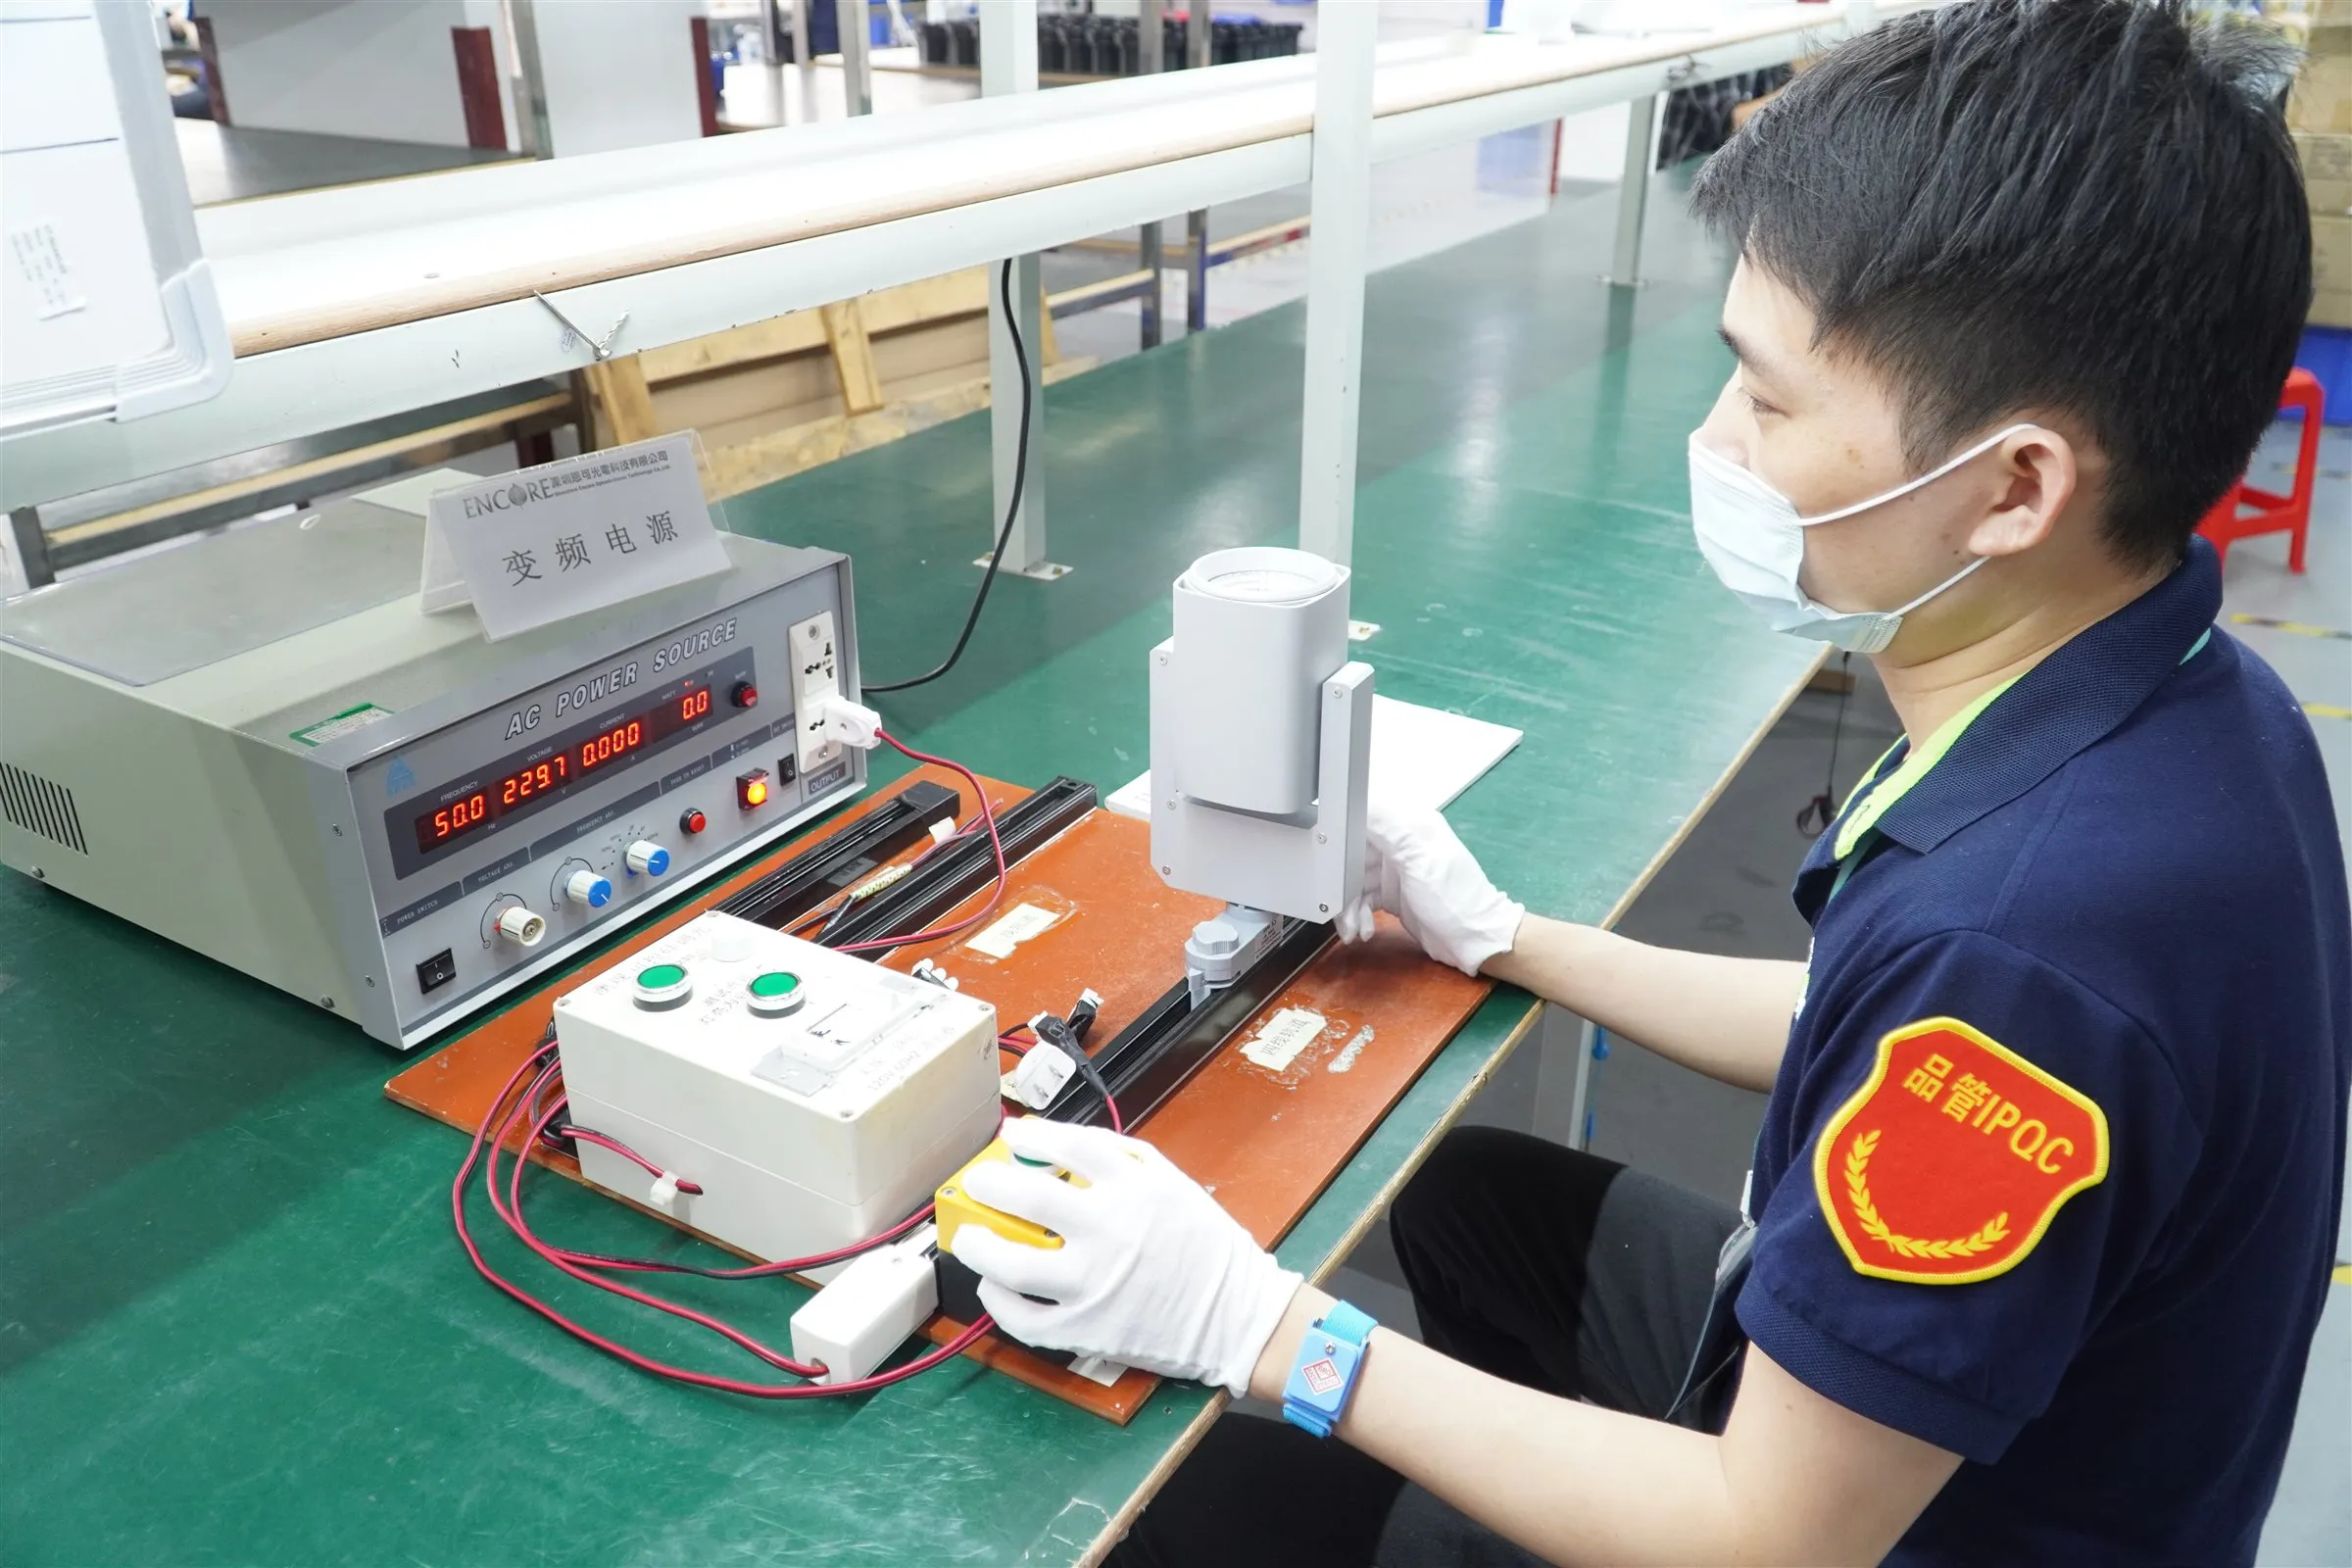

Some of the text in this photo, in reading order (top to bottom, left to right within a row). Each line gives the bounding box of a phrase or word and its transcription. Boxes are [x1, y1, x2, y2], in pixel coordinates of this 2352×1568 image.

[503, 511, 678, 586] 变频电源
[505, 618, 737, 740] AC POWER SOURCE
[600, 713, 625, 729] CURRENT
[527, 746, 553, 761] VOLTAGE
[441, 780, 478, 802] FREQUENCY
[810, 771, 840, 792] OUTPUT
[1902, 1054, 2075, 1175] 品管IPQC
